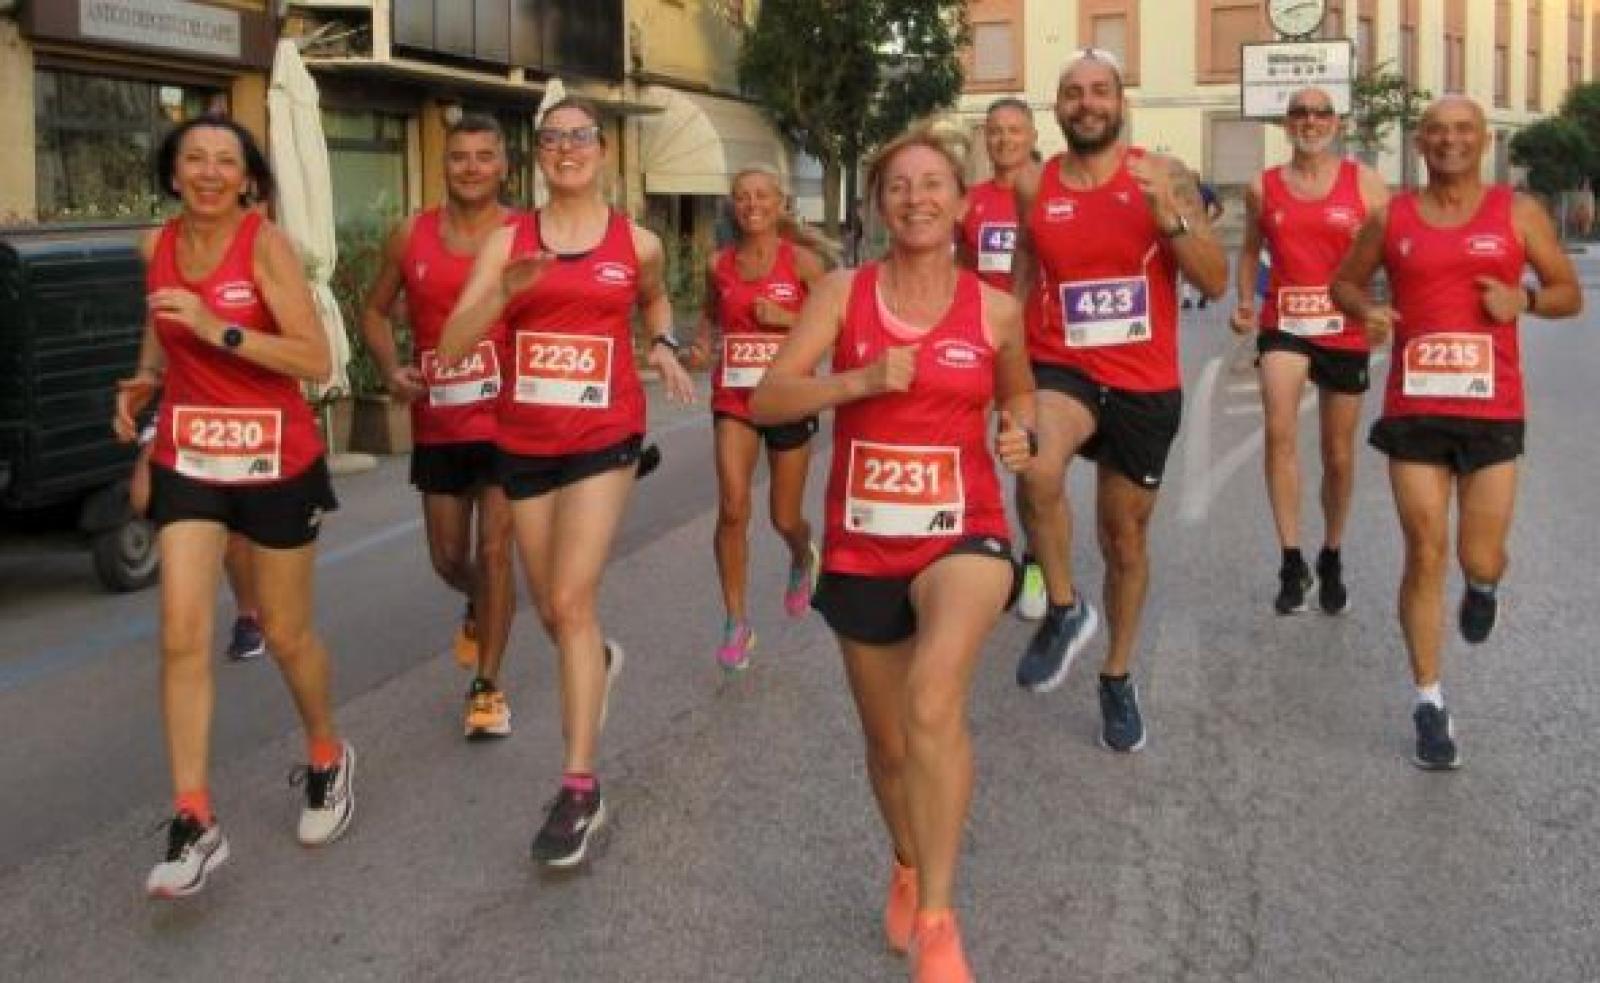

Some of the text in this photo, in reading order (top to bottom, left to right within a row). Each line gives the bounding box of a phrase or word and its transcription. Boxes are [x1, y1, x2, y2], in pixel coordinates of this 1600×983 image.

[1075, 288, 1133, 314] 423
[529, 343, 596, 373] 2236
[1417, 342, 1480, 366] 2235
[190, 418, 263, 449] 2230
[863, 456, 940, 495] 2231
